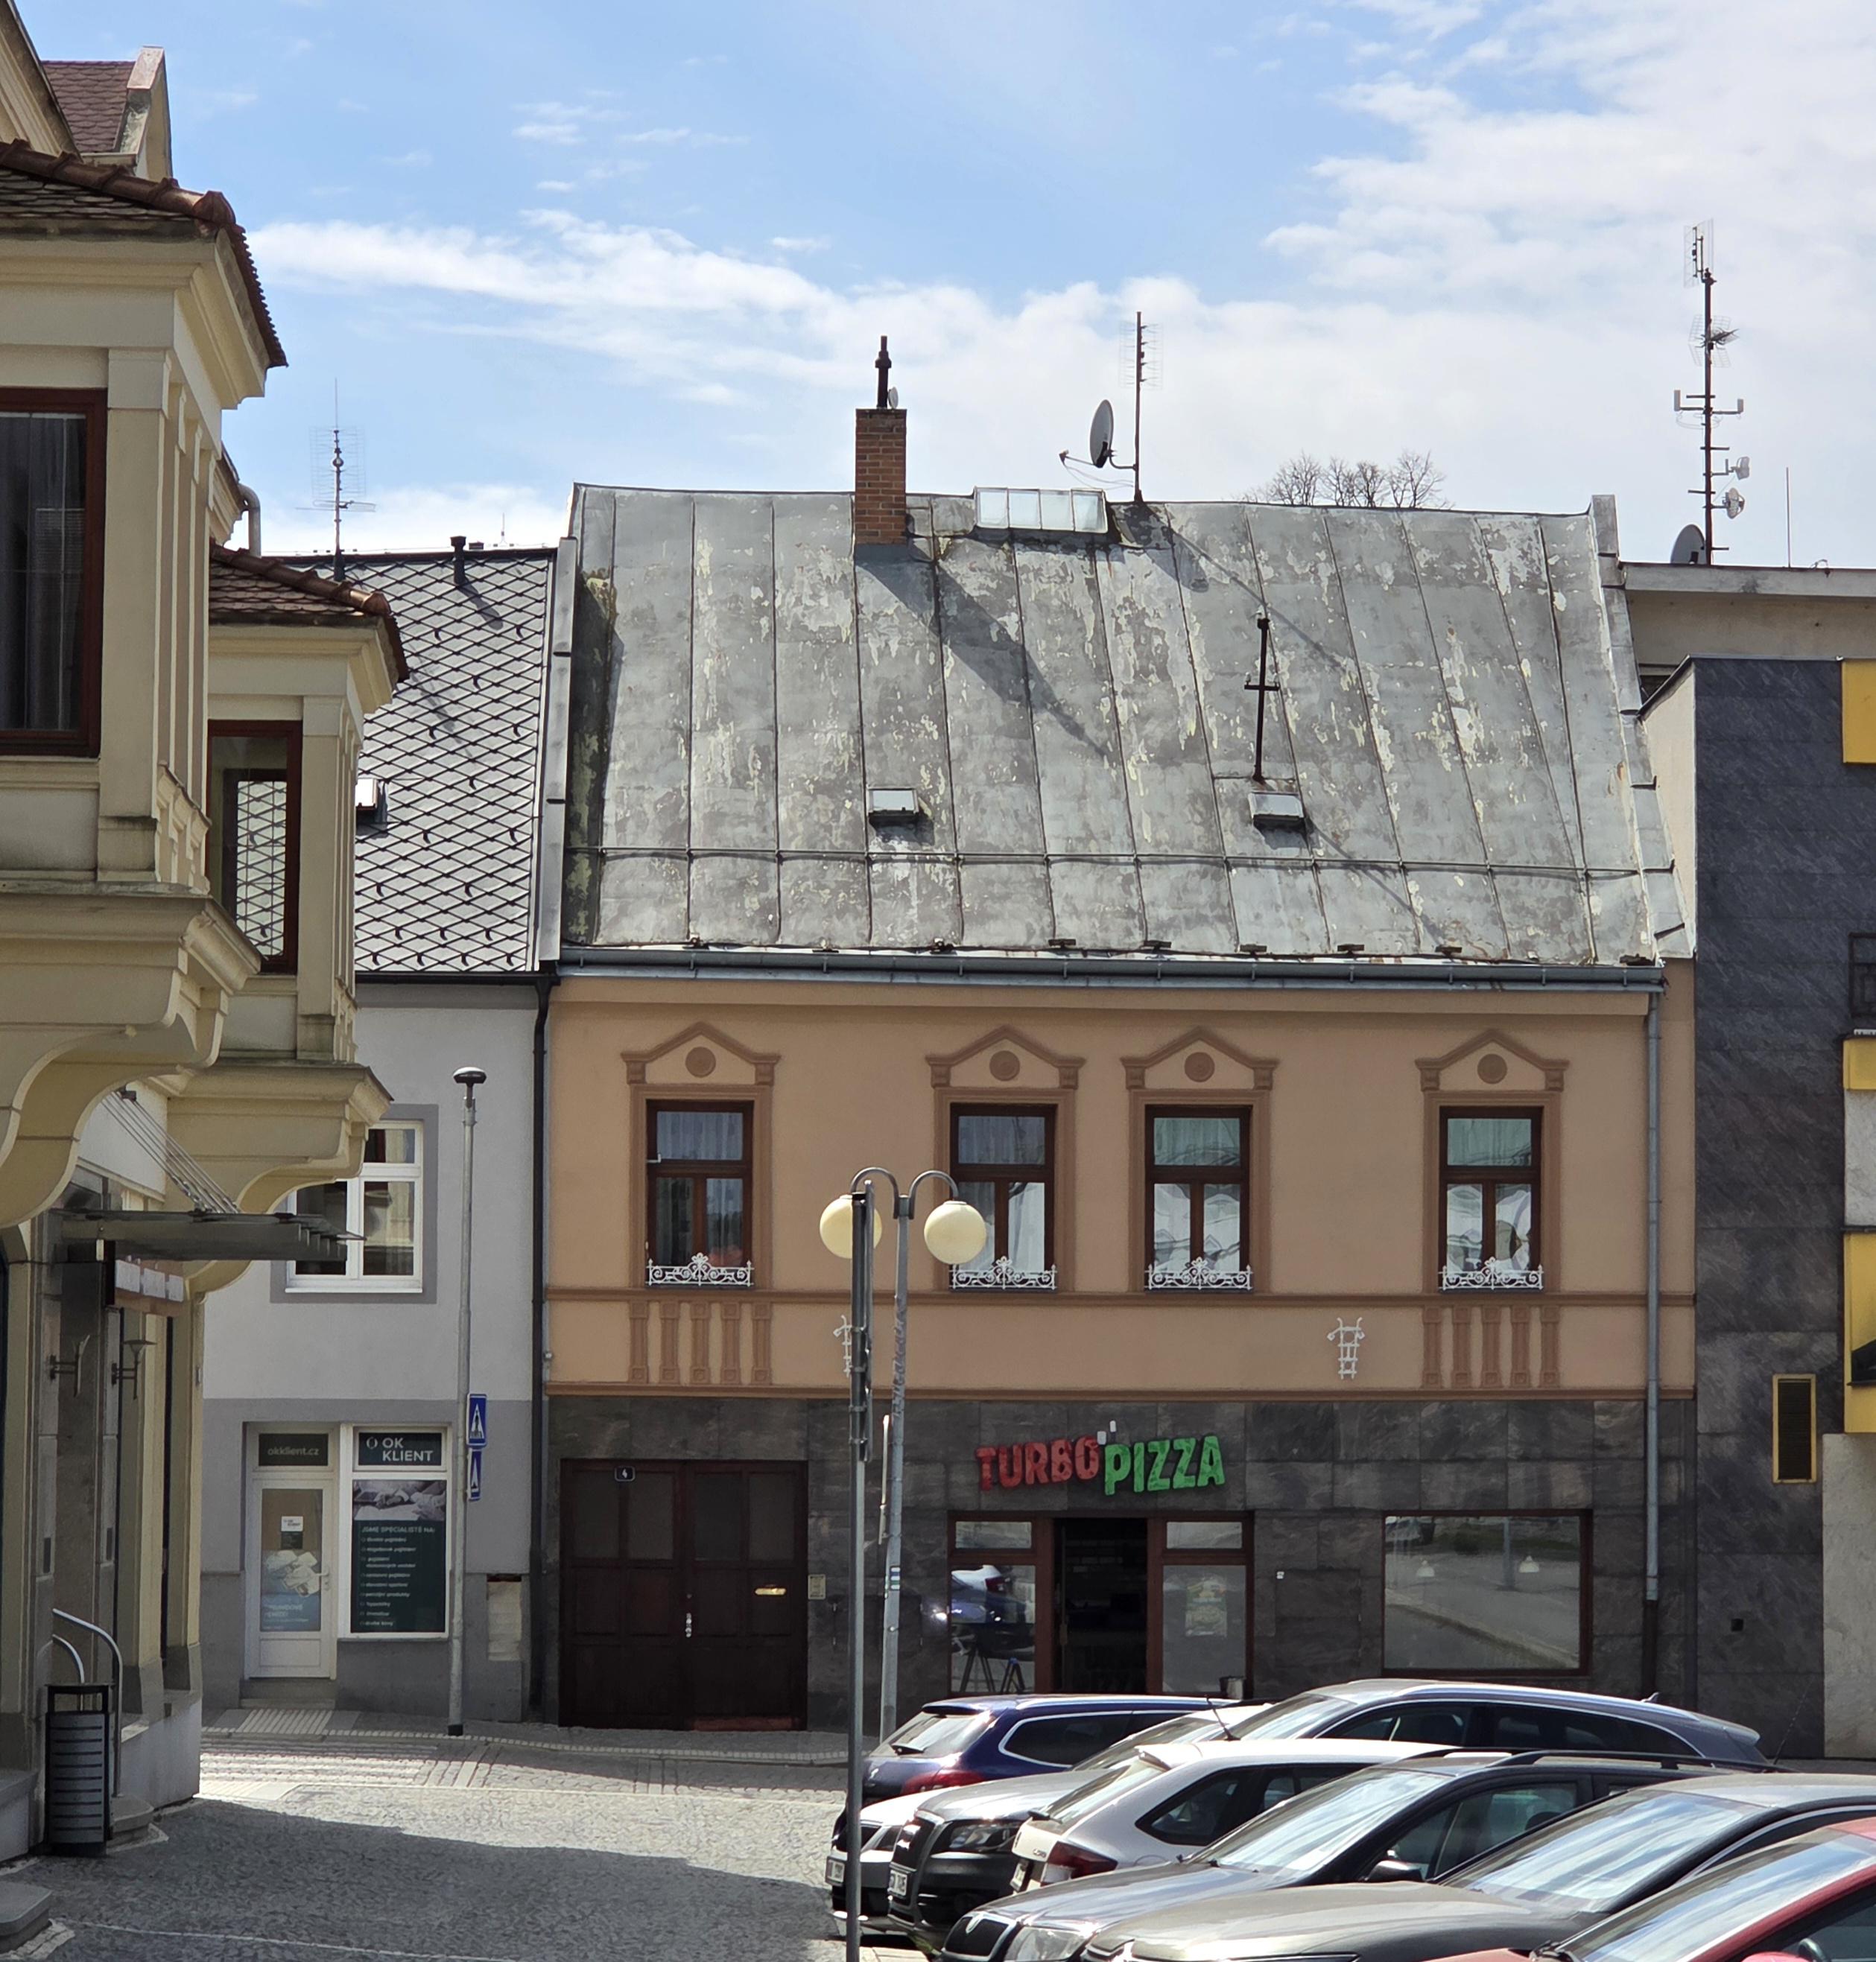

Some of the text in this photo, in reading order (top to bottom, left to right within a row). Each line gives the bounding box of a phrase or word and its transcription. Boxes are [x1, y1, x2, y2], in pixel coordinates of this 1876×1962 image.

[382, 1437, 404, 1449] OK
[267, 1446, 320, 1456] okklient.cz
[382, 1450, 434, 1462] KLIENT
[976, 1435, 1226, 1496] TURBO PIZZA
